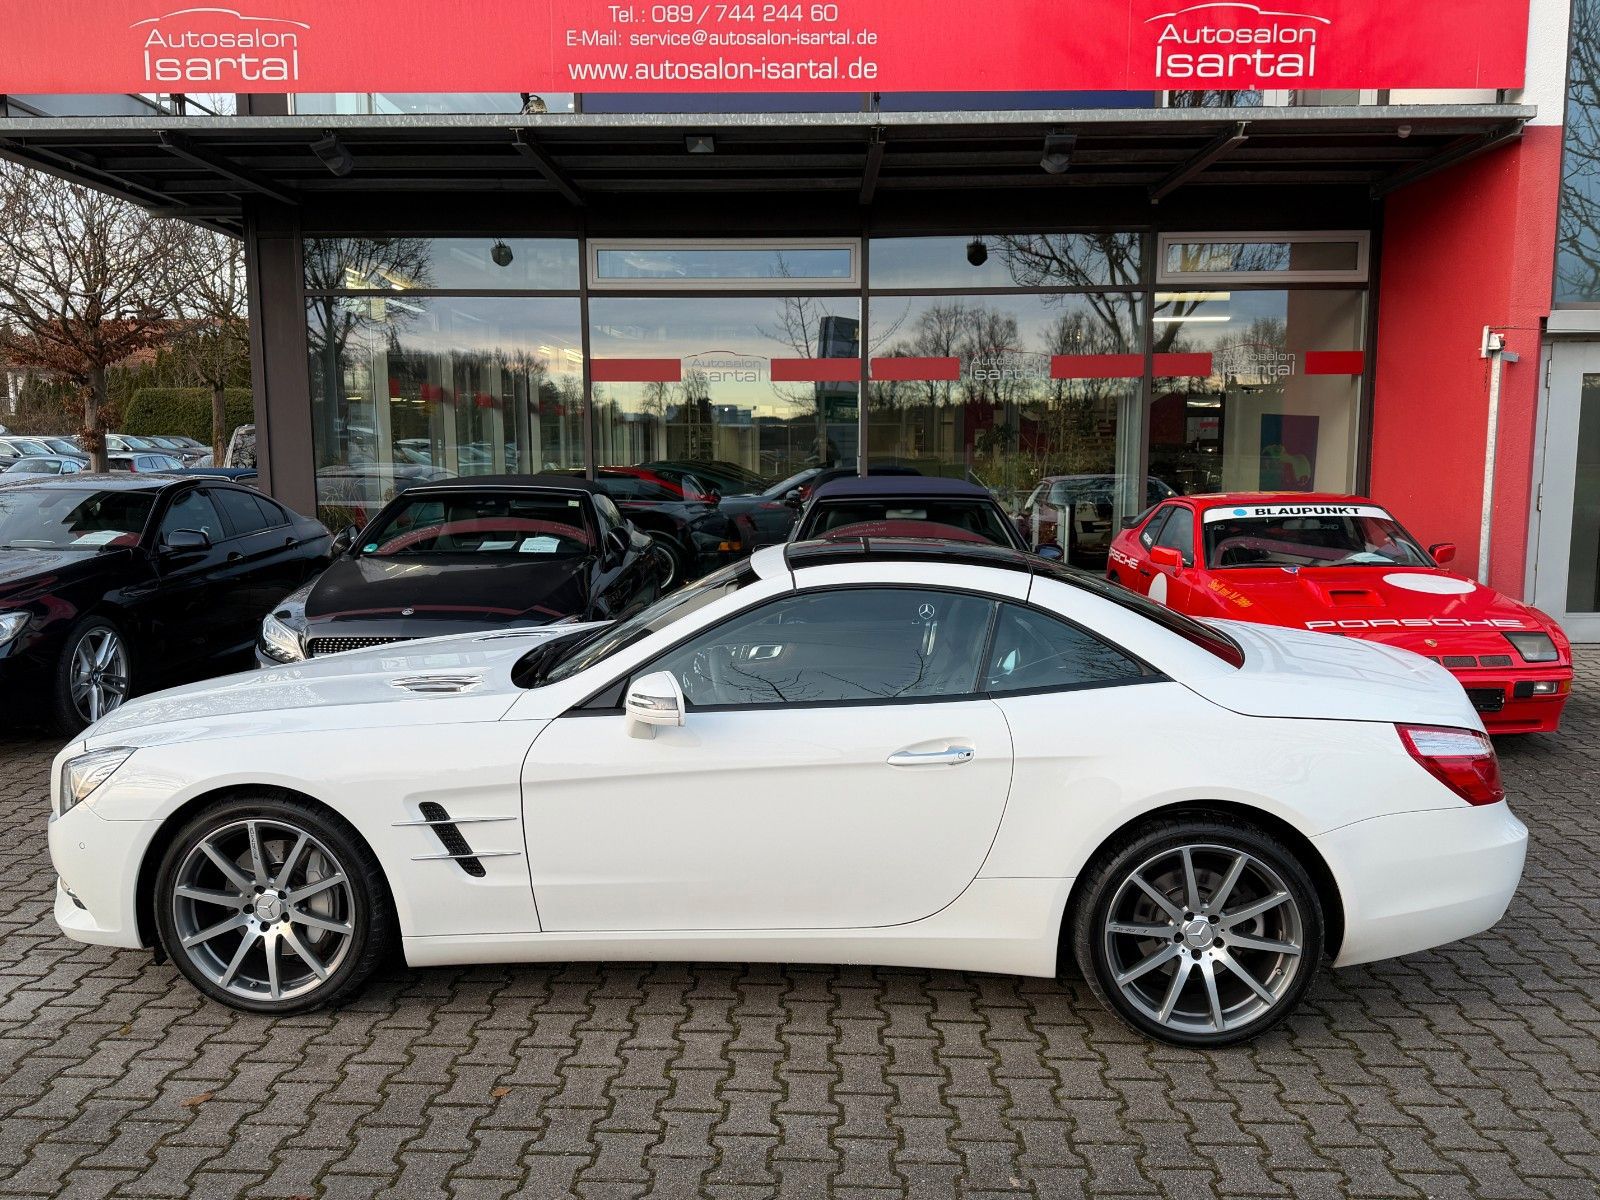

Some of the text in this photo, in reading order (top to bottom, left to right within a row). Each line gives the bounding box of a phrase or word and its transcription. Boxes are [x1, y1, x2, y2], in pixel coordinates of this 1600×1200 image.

[608, 5, 645, 22] Tel.:
[651, 4, 693, 23] 089
[715, 5, 755, 22] 744
[763, 4, 803, 22] 244
[810, 4, 839, 22] 60
[144, 28, 298, 48] Autosalon
[566, 29, 878, 46] E-Mail: service@autosalon-isartal.de
[1157, 23, 1317, 44] Autosalon
[144, 49, 299, 81] Isartal
[568, 56, 878, 80] www.autosalon-isartal.de
[1155, 44, 1316, 77] Isartal
[692, 358, 762, 368] Autosalon
[1255, 507, 1360, 516] BLAUPUNKT
[1304, 617, 1527, 630] PORSCHE
